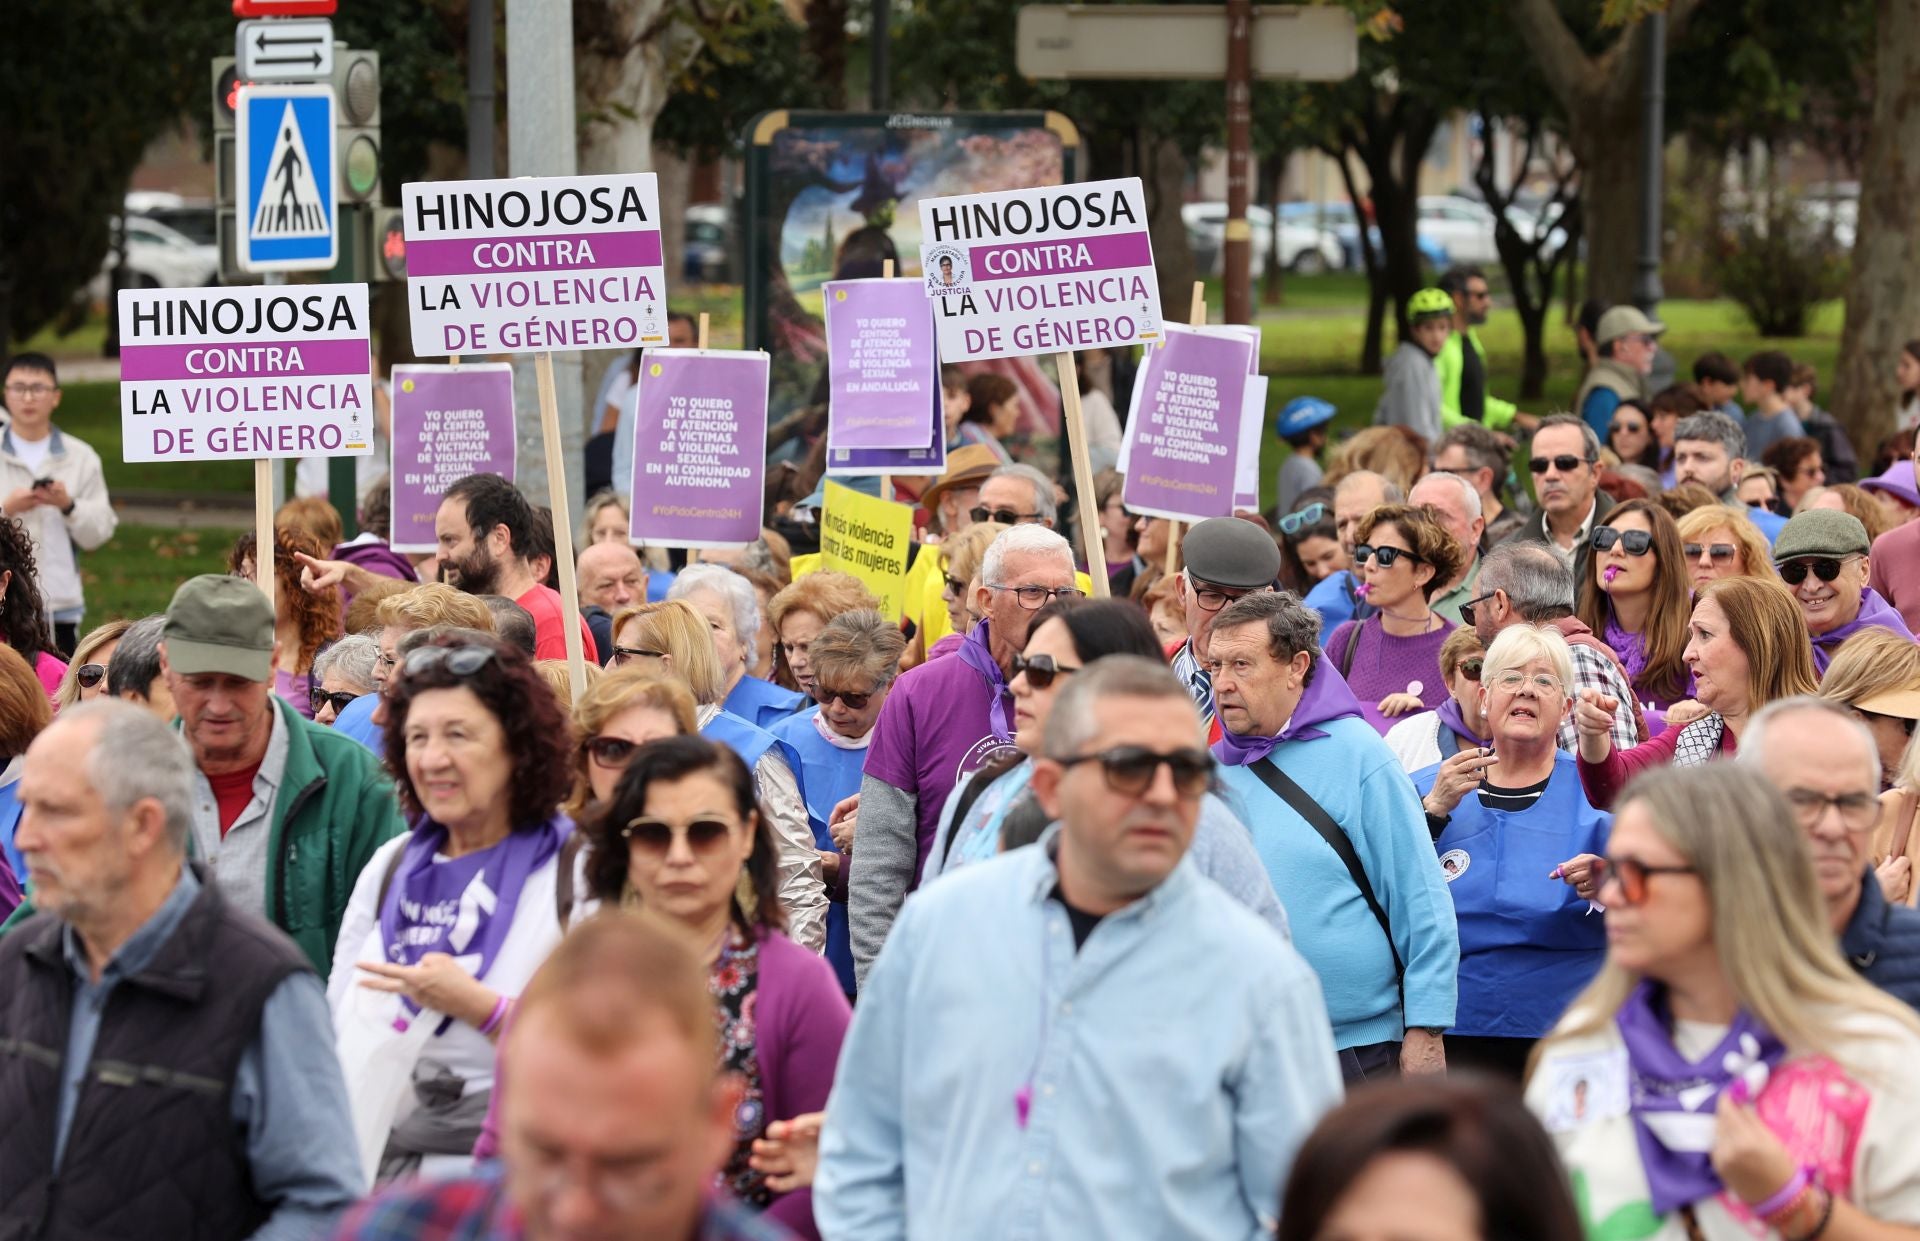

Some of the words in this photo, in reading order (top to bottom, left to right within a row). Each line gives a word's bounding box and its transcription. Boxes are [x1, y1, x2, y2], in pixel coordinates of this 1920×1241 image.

[416, 186, 648, 231] HINOJOSA
[931, 190, 1137, 242] HINOJOSA
[472, 239, 596, 268] CONTRA
[984, 243, 1094, 275] CONTRA
[420, 284, 461, 311] LA
[470, 275, 656, 309] VIOLENCIA
[930, 287, 972, 296] JUSTICIA
[941, 294, 979, 317] LA
[985, 275, 1150, 313] VIOLENCIA
[132, 295, 357, 337] HINOJOSA
[870, 318, 907, 328] QUIERO
[443, 323, 487, 351] DE
[499, 315, 637, 348] GÉNERO
[859, 329, 900, 338] CENTROS
[964, 327, 1004, 354] DE
[1013, 315, 1135, 350] GÉNERO
[850, 339, 862, 348] DE
[185, 346, 304, 374] CONTRA
[849, 359, 860, 369] DE
[862, 359, 912, 368] VIOLENCIA
[862, 369, 897, 378] SEXUAL
[1164, 370, 1177, 381] YO
[1179, 372, 1217, 387] QUIERO
[846, 383, 860, 393] EN
[861, 379, 920, 393] ANDALUCÍA
[1160, 381, 1175, 392] UN
[1177, 384, 1217, 399] CENTRO
[132, 389, 171, 415] LA
[181, 383, 361, 413] VIOLENCIA
[670, 396, 686, 407] YO
[690, 398, 732, 409] QUIERO
[1156, 391, 1168, 402] DE
[668, 408, 685, 418] UN
[688, 409, 733, 421] CENTRO
[1158, 403, 1165, 413] A
[425, 411, 441, 421] YO
[444, 409, 483, 422] QUIERO
[424, 421, 440, 431] UN
[443, 421, 485, 431] CENTRO
[663, 419, 677, 429] DE
[1152, 413, 1164, 424] DE
[1166, 415, 1219, 433] VIOLENCIA
[153, 428, 195, 454] DE
[206, 421, 342, 452] GÉNERO
[419, 432, 433, 442] DE
[667, 431, 676, 440] A
[1164, 426, 1203, 441] SEXUAL
[424, 443, 432, 452] A
[660, 441, 674, 452] DE
[678, 442, 739, 455] VIOLENCIA
[1139, 433, 1153, 444] EN
[1153, 435, 1165, 446] MI
[1167, 438, 1228, 456] COMUNIDAD
[417, 453, 432, 463] DE
[435, 452, 491, 463] VIOLENCIA
[677, 453, 721, 465] SEXUAL
[434, 463, 475, 474] SEXUAL
[646, 463, 661, 474] EN
[665, 464, 678, 474] MI
[682, 465, 751, 478] COMUNIDAD
[405, 474, 420, 484] EN
[423, 474, 436, 484] MI
[833, 514, 847, 535] más
[849, 519, 894, 549] violencia
[841, 539, 854, 562] las
[856, 549, 901, 576] mujeres
